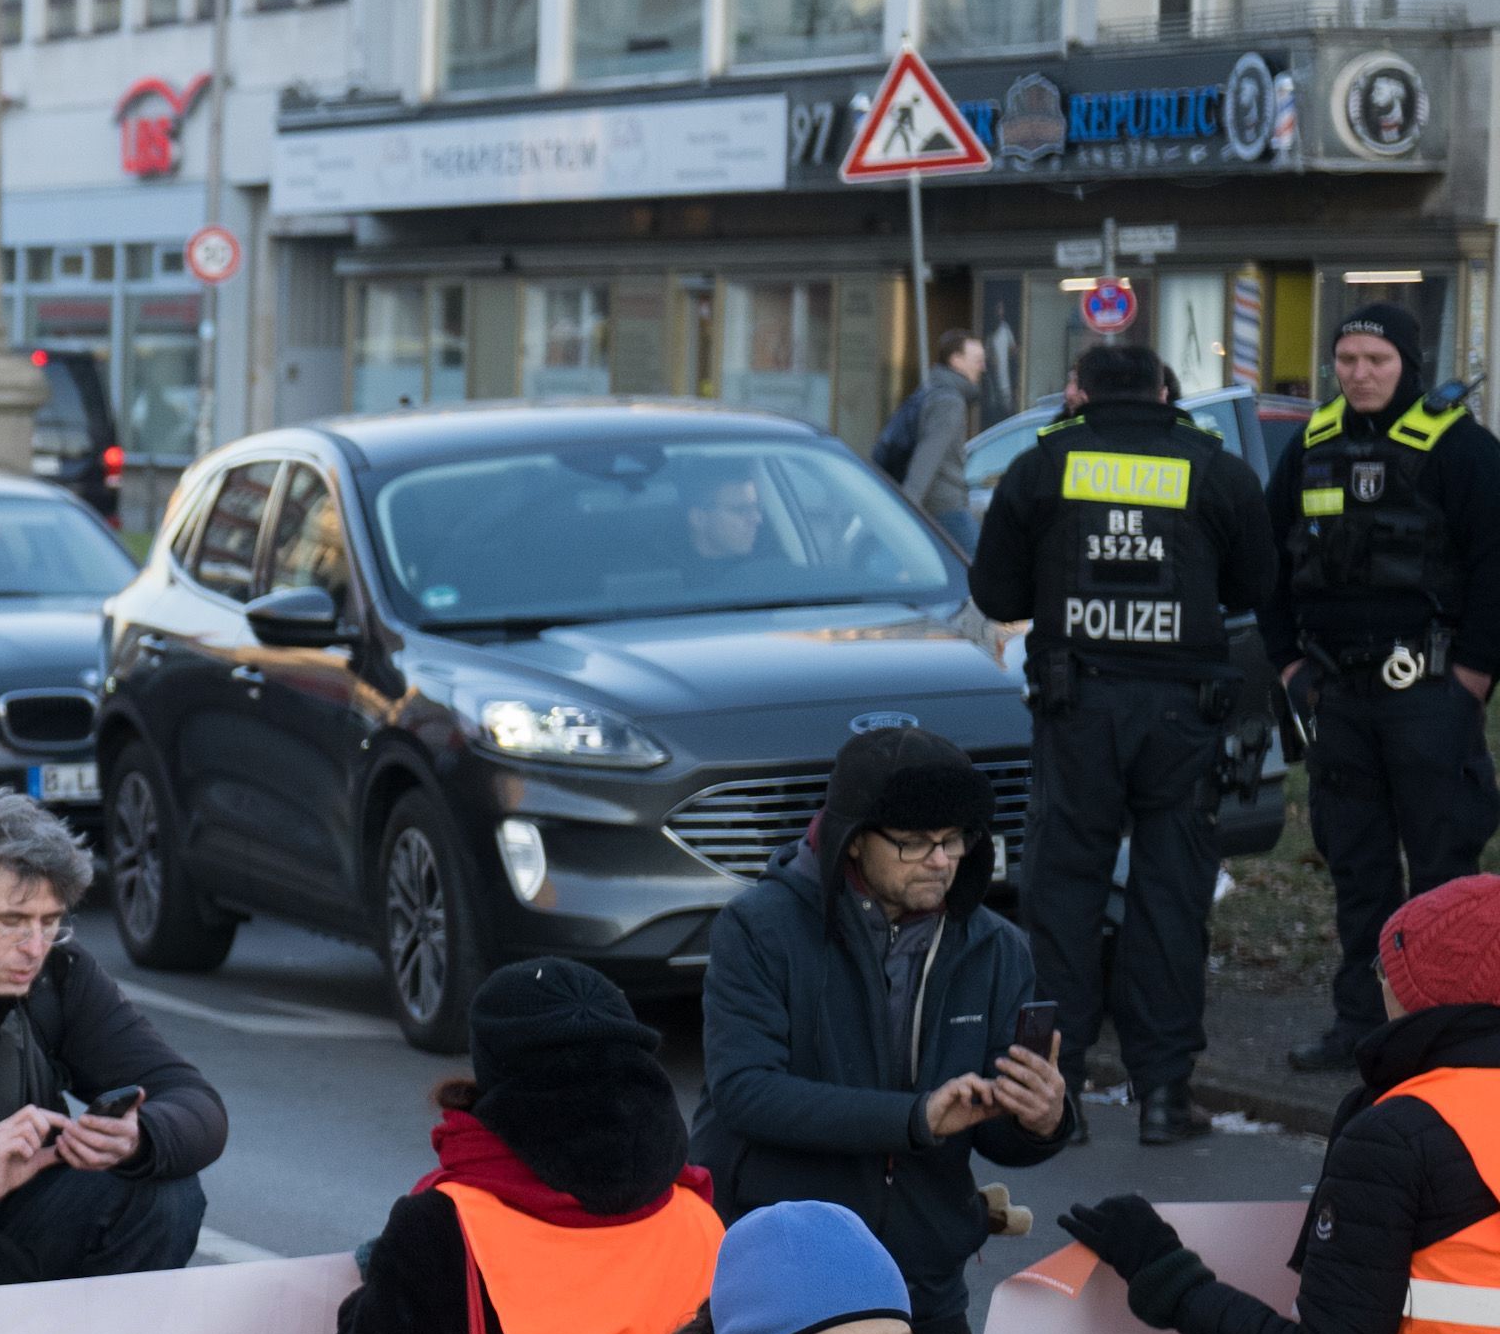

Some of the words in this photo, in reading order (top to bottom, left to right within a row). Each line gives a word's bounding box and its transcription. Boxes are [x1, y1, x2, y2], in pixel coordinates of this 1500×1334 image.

[793, 101, 834, 165] 97
[1070, 85, 1217, 142] REPUBLIC
[1070, 457, 1185, 500] POLIZEI
[1108, 510, 1144, 535] BE
[1086, 535, 1165, 561] 35224
[1064, 597, 1181, 643] POLIZEI
